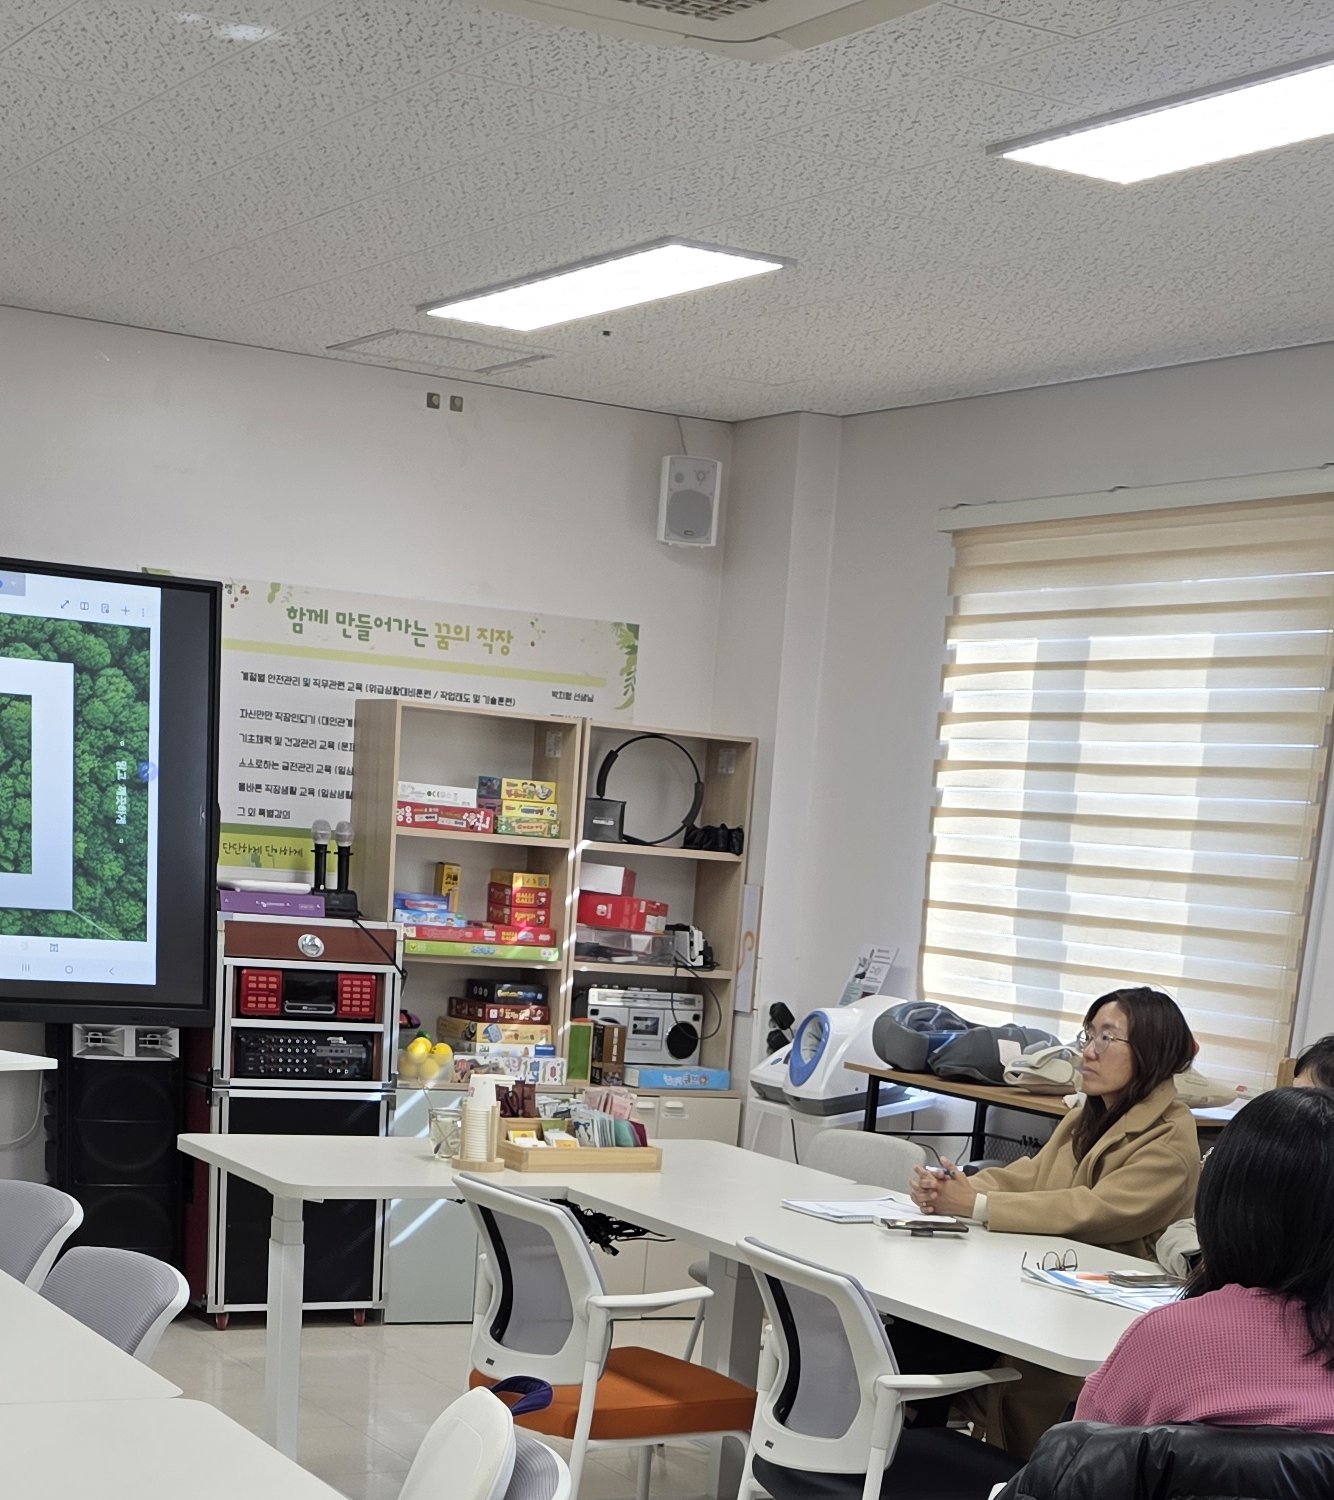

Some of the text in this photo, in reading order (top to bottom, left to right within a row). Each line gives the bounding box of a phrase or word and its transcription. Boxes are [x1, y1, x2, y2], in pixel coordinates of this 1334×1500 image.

[287, 605, 513, 656] 함께 만들어가는 꿈의 직장
[268, 674, 300, 686] 안전관리
[303, 678, 310, 687] 및
[347, 682, 362, 692] 교육
[239, 709, 272, 720] 자신만만
[275, 712, 315, 724] 직장인되기
[285, 737, 316, 749] 건강관리
[319, 740, 334, 750] 교육
[239, 758, 279, 770] 스스로하는
[282, 761, 314, 773] 금전관리
[316, 764, 331, 774] 교육
[265, 784, 297, 795] 직장생활
[299, 787, 315, 797] 교육
[237, 807, 245, 816] 그
[259, 808, 290, 819] 특별강의
[223, 842, 262, 855] 단단하게
